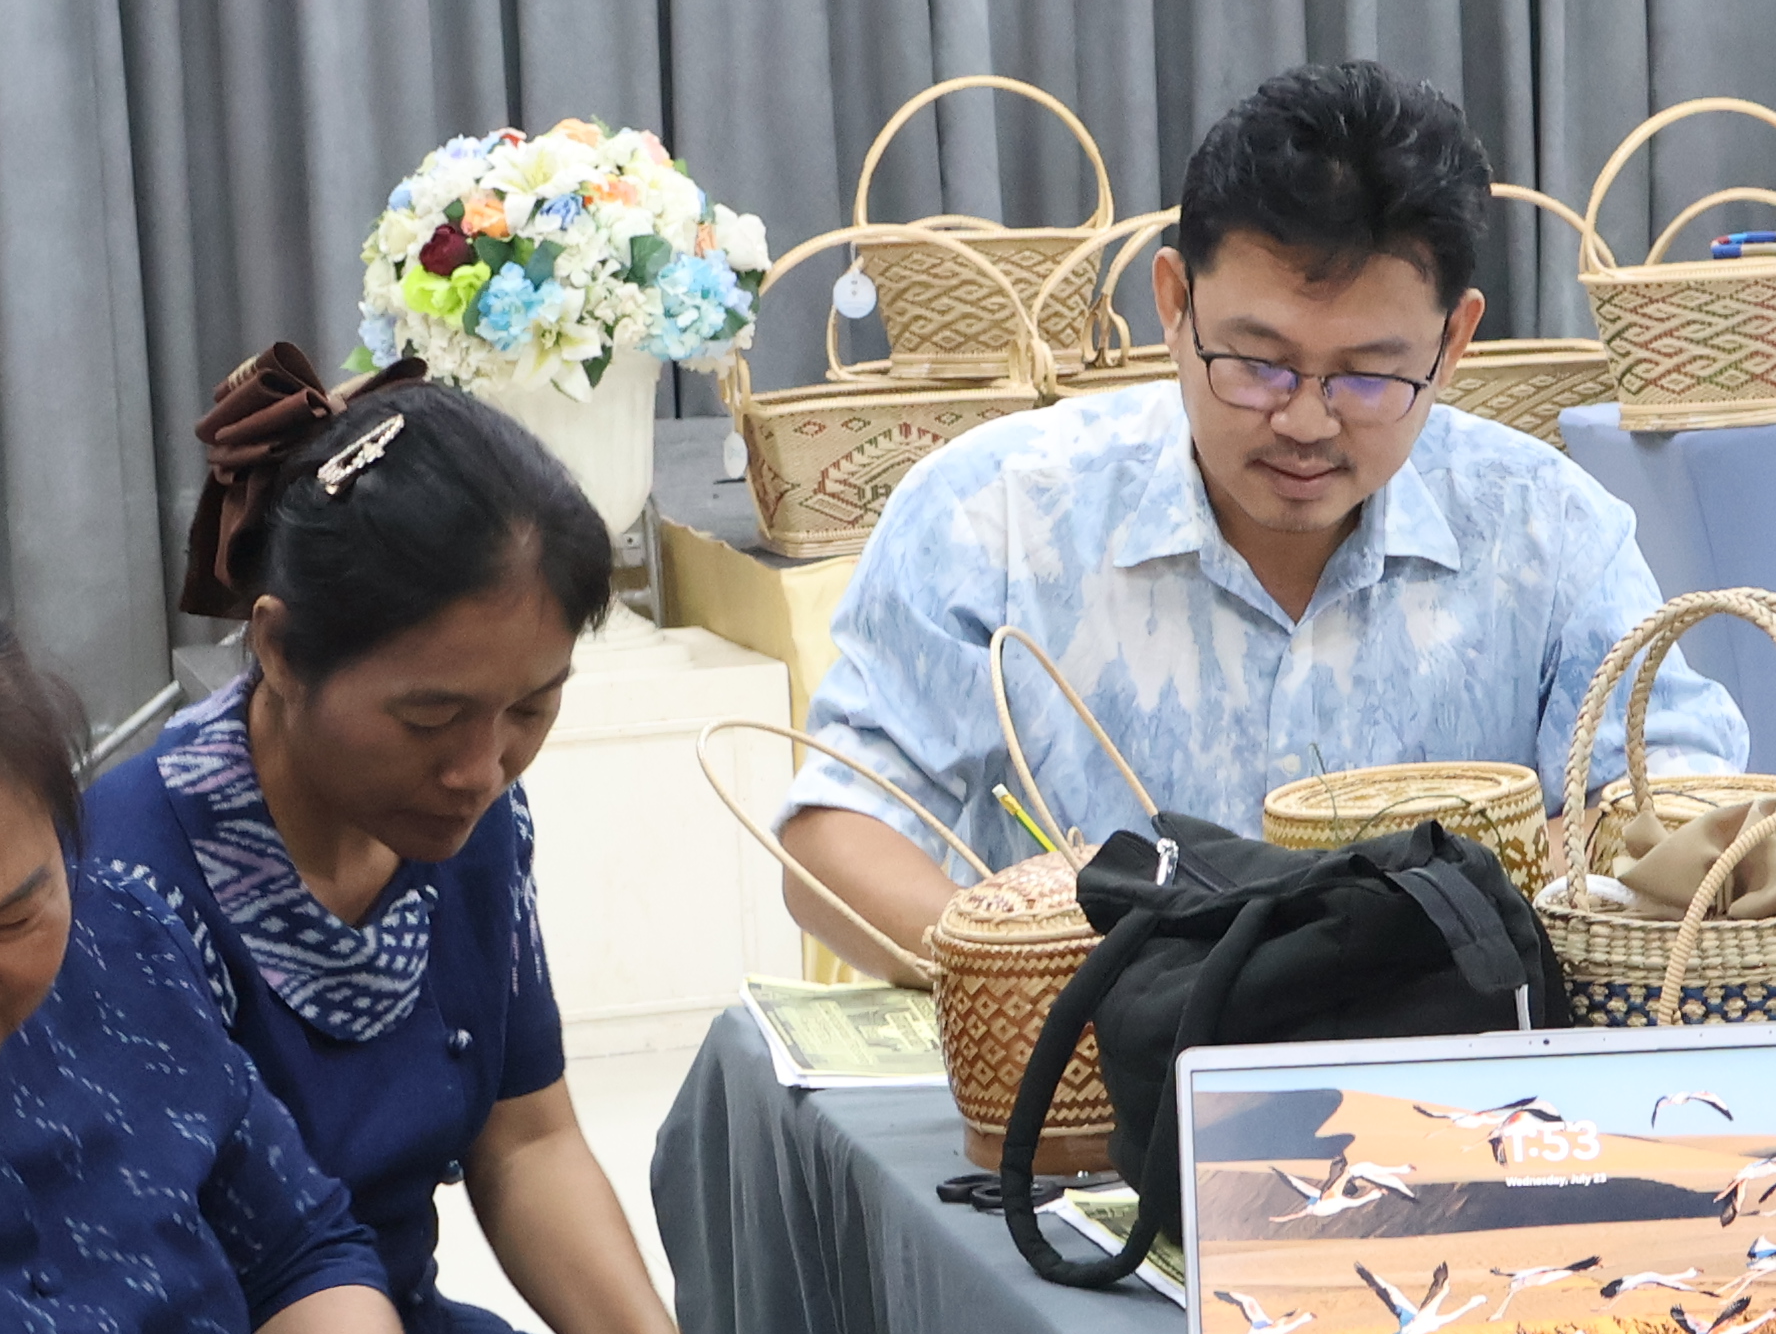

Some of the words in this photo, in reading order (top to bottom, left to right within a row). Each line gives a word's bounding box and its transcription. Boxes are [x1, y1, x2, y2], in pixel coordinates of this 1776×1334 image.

[1503, 1120, 1601, 1163] 1:53
[1505, 1174, 1568, 1187] Wednesday,
[1570, 1173, 1592, 1187] July
